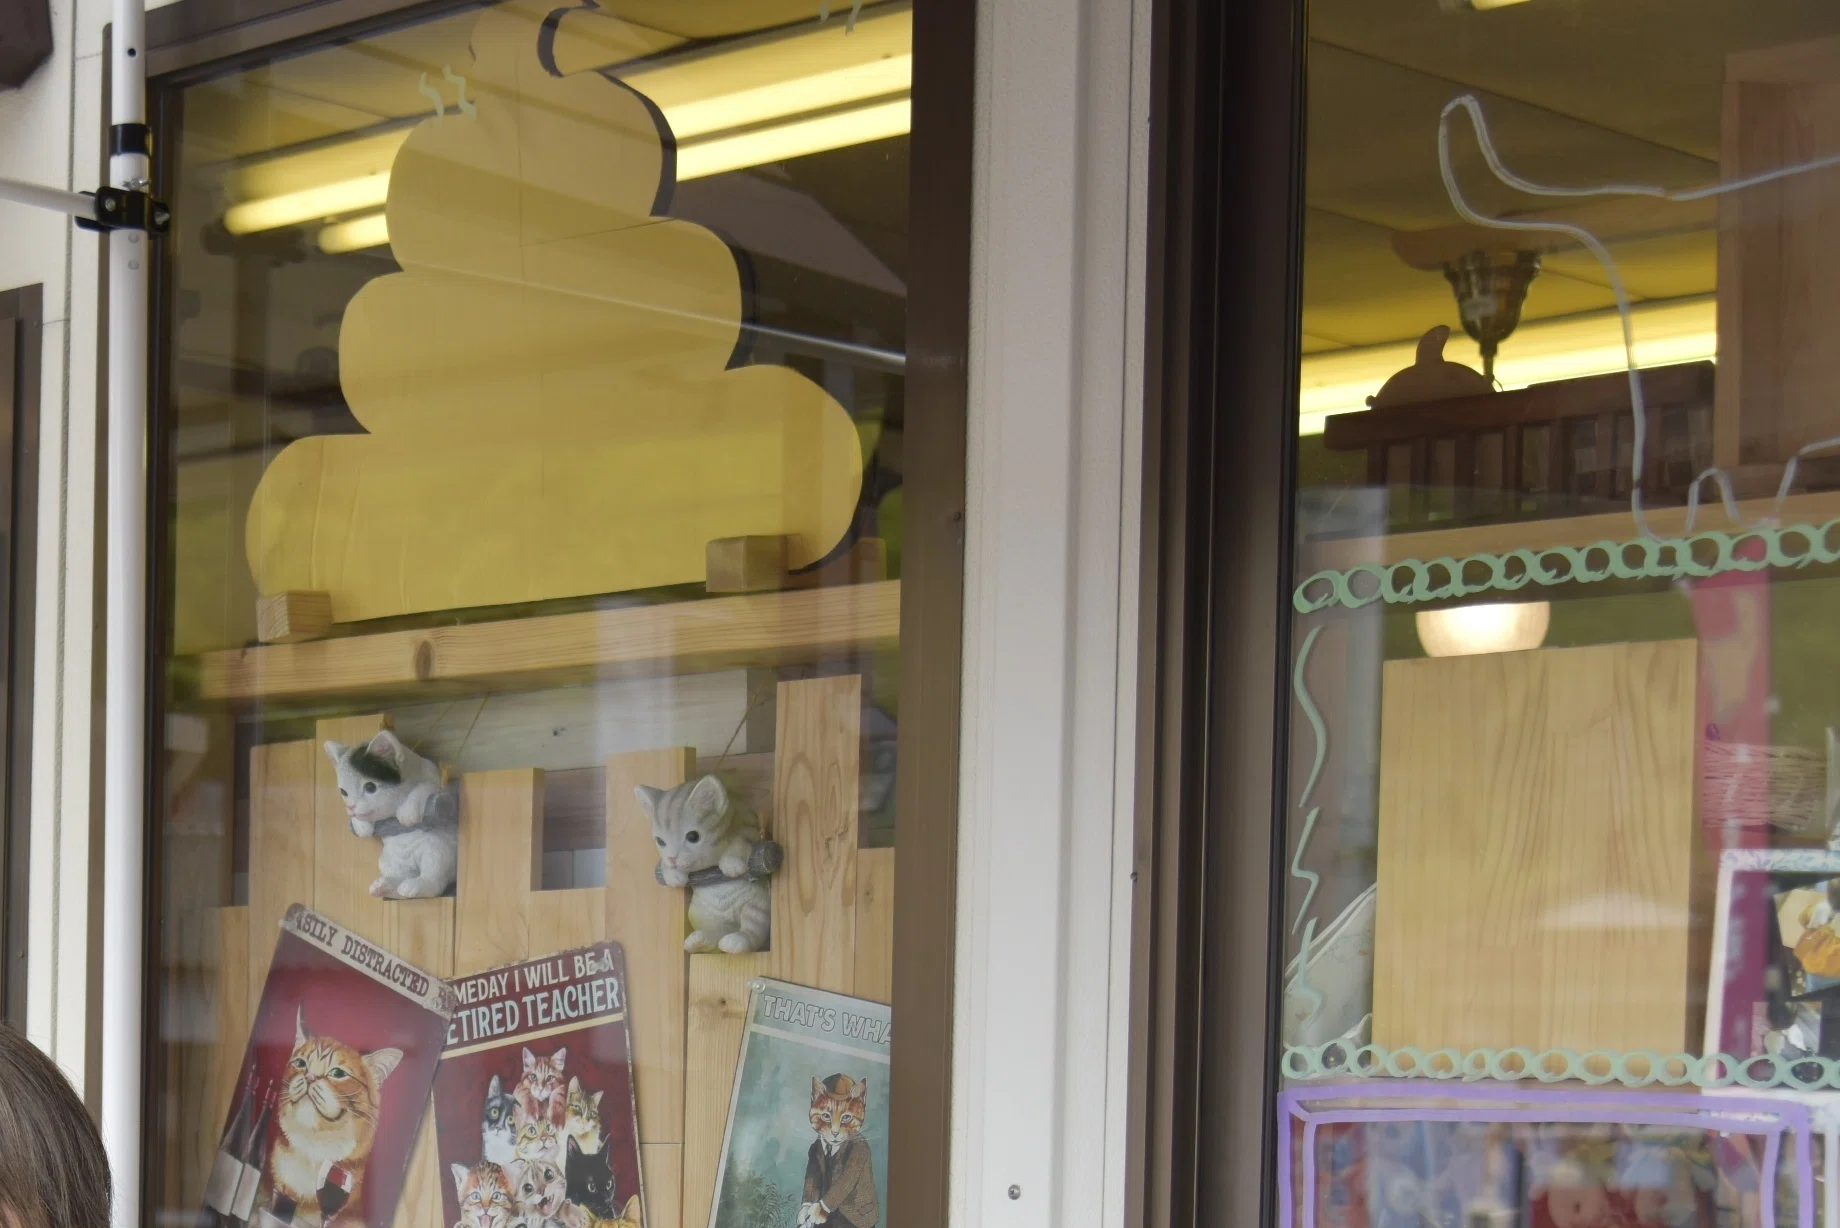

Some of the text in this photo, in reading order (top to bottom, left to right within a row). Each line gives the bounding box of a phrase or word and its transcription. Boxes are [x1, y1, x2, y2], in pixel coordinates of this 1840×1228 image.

[294, 910, 339, 948] SILY
[342, 935, 430, 998] DISTRACTED
[456, 973, 509, 1005] MEDAY
[514, 967, 520, 985] I
[524, 960, 570, 990] WILL
[574, 951, 595, 976] BE
[446, 977, 621, 1046] ETIRED TEACHER
[763, 995, 891, 1045] THAT'S WHA
